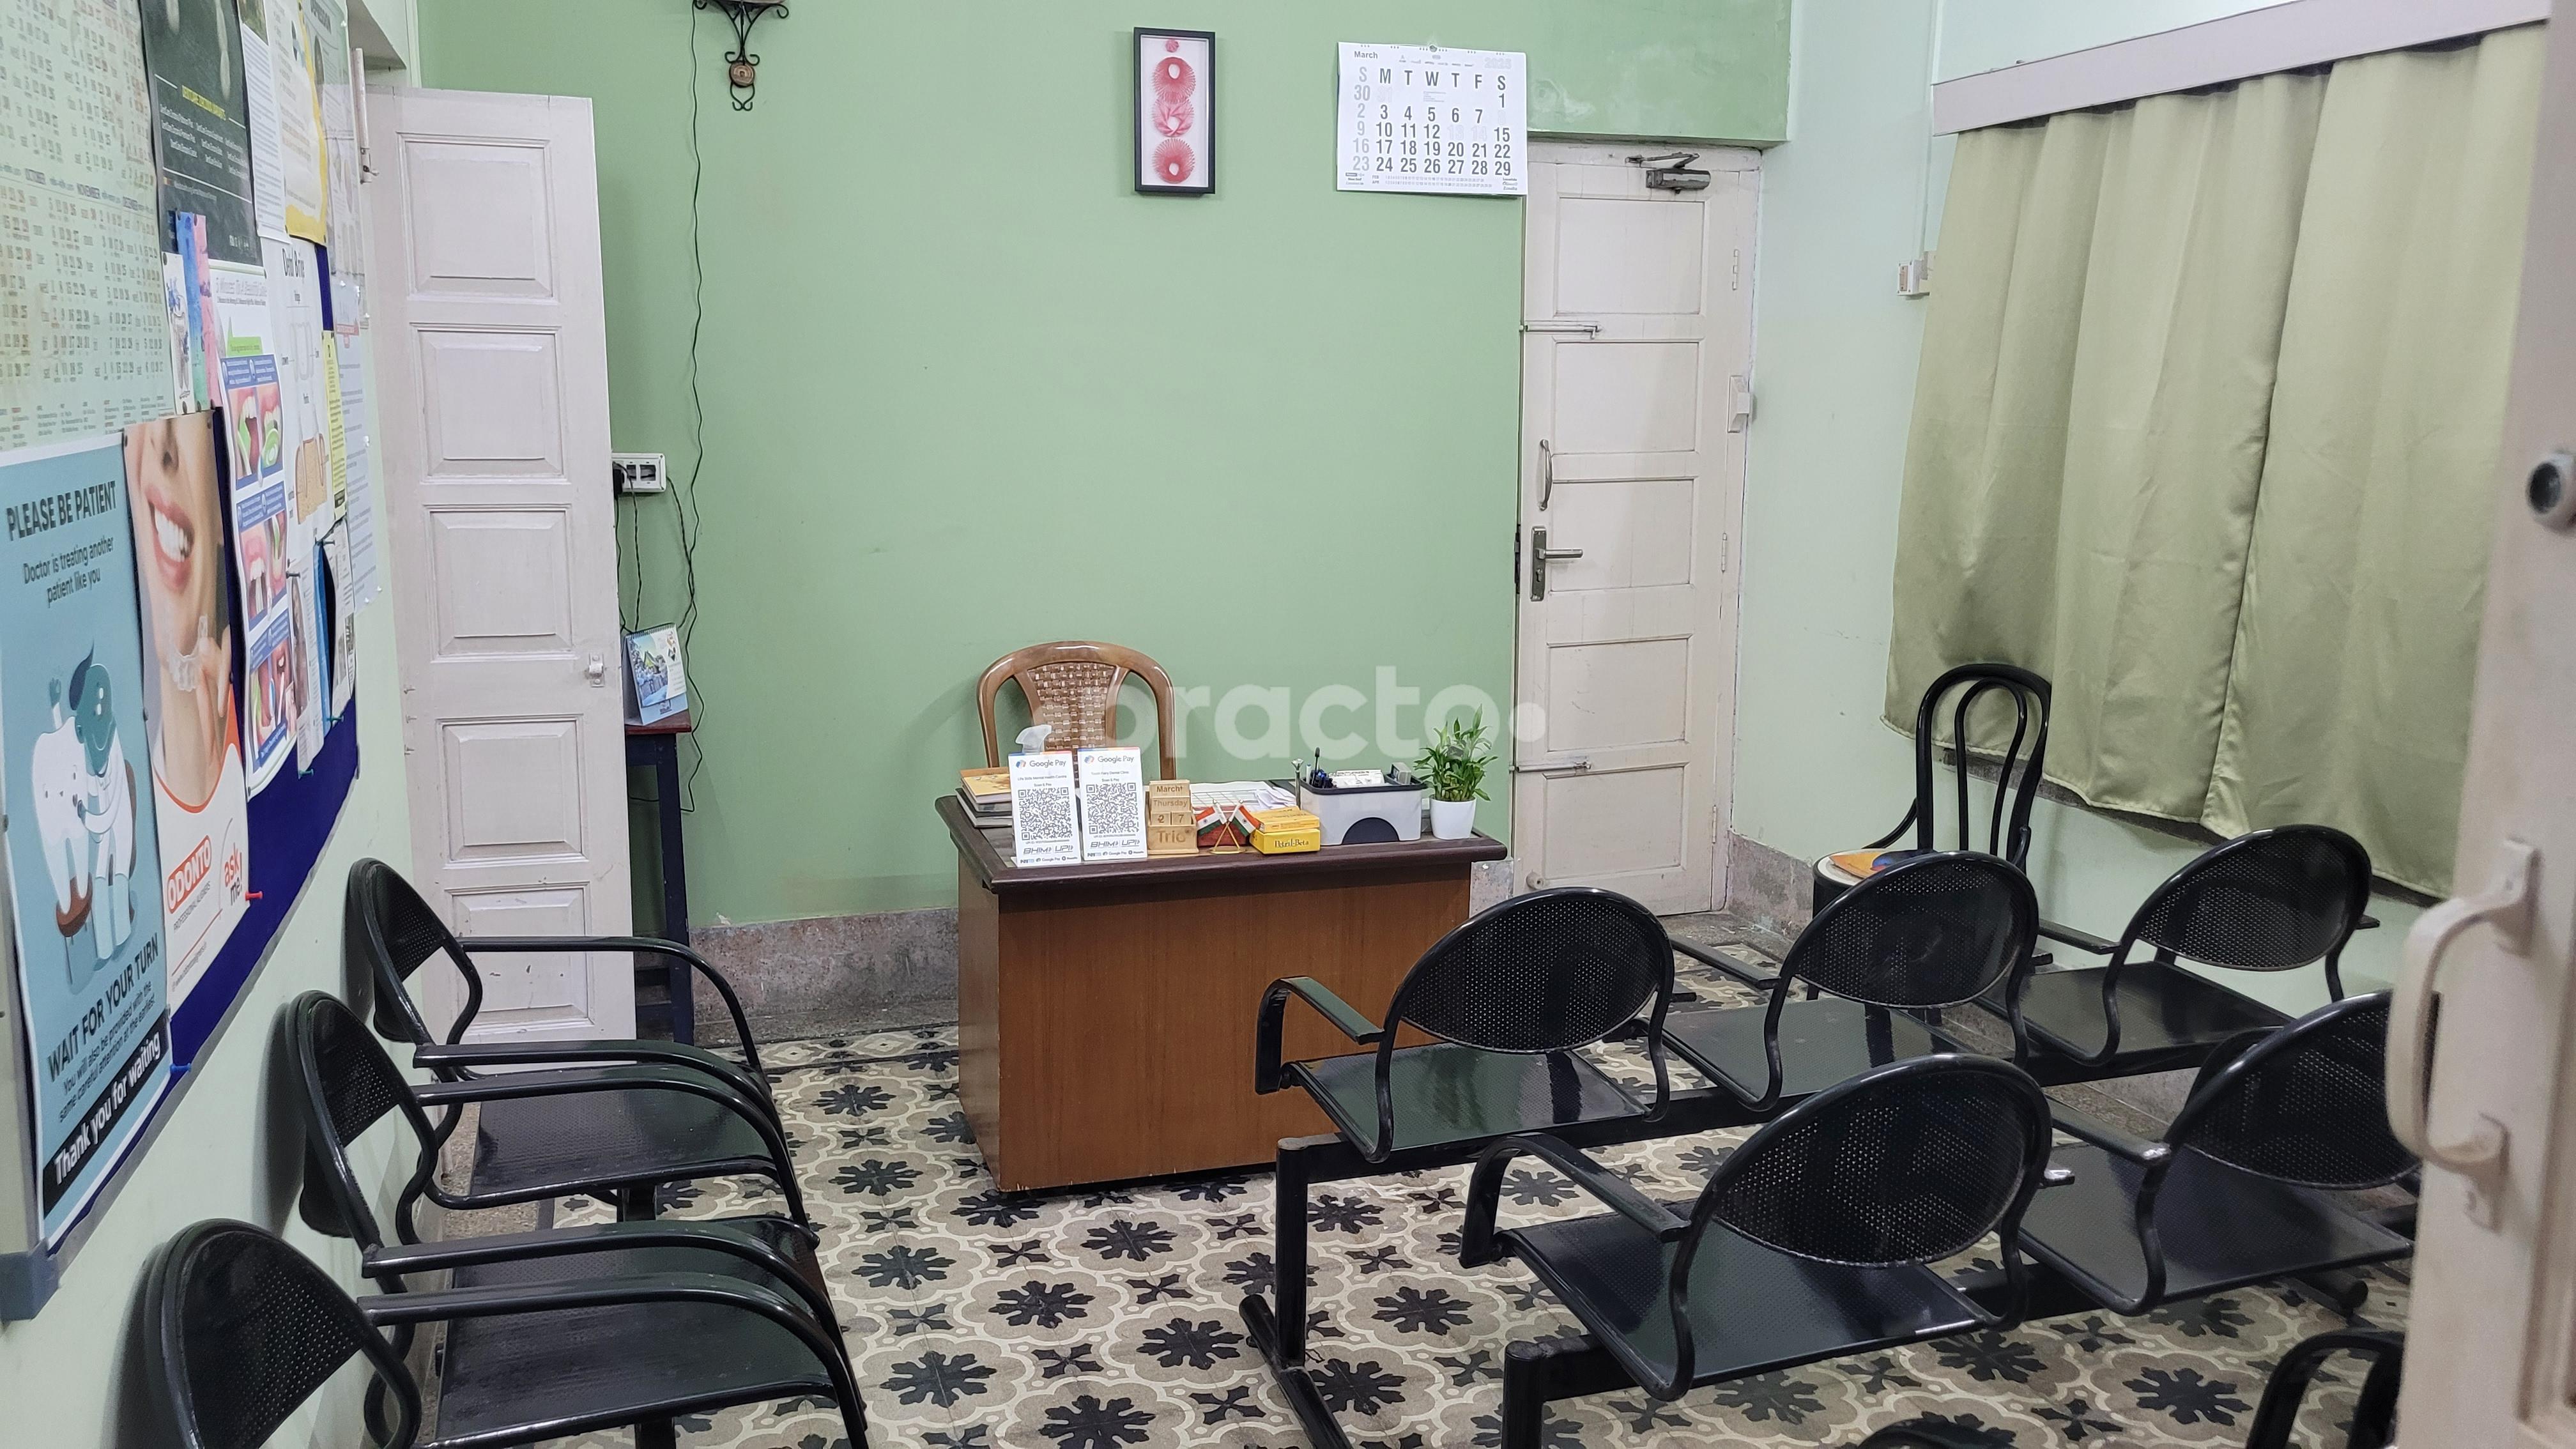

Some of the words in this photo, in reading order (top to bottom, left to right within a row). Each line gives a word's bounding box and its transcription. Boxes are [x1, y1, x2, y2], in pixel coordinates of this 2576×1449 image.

[1354, 50, 1377, 59] March
[1359, 66, 1367, 82] S
[1380, 68, 1391, 84] M
[1404, 70, 1413, 85] T
[1425, 72, 1439, 86] W
[1451, 73, 1459, 87] T
[1475, 74, 1482, 89] F
[1497, 75, 1506, 90] S
[1354, 85, 1370, 101] 30
[1499, 93, 1505, 108] 1
[1357, 103, 1365, 118] 2
[1380, 105, 1388, 119] 3
[1404, 106, 1412, 120] 4
[1428, 107, 1436, 121] 5
[1452, 108, 1459, 123] 6
[1475, 109, 1482, 124] 7
[1357, 121, 1365, 136] 9
[1376, 123, 1393, 137] 10
[1401, 123, 1416, 138] 11
[1424, 125, 1440, 139] 12
[1494, 127, 1510, 142] 15
[1353, 139, 1369, 153] 16
[1376, 140, 1393, 154] 17
[1400, 141, 1416, 155] 18
[1424, 141, 1440, 156] 19
[1448, 142, 1464, 157] 20
[1472, 143, 1486, 158] 21
[1494, 144, 1510, 158] 22
[1353, 156, 1370, 171] 23
[1376, 157, 1393, 171] 24
[1400, 158, 1416, 172] 25
[1424, 159, 1441, 174] 26
[1448, 160, 1464, 174] 27
[1471, 160, 1487, 175] 28
[1495, 162, 1511, 176] 29
[6, 496, 56, 541] PLEASE
[57, 492, 73, 526] BE
[74, 480, 117, 521] PATIENT
[24, 557, 50, 584] Doctor
[52, 553, 59, 573] is
[59, 544, 88, 570] treating
[89, 535, 114, 560] another
[47, 578, 74, 608] patient
[74, 570, 87, 593] like
[88, 567, 100, 590] you
[1029, 760, 1053, 769] Google
[1153, 799, 1187, 808] Thursday
[1158, 815, 1164, 823] 2
[1178, 815, 1184, 823] 7
[1156, 830, 1185, 843] Trio
[168, 838, 211, 910] ODONTO
[224, 842, 240, 887] ask
[230, 852, 243, 906] me!
[47, 1025, 79, 1082] WAIT
[82, 998, 105, 1046] FOR
[105, 963, 134, 1019] YOUR
[134, 931, 158, 983] TURN
[64, 1077, 76, 1096] You
[77, 1057, 88, 1080] will
[89, 1048, 100, 1068] also
[101, 1036, 108, 1052] be
[109, 1002, 132, 1045] provided
[134, 990, 143, 1011] with
[59, 1094, 77, 1123] same
[77, 1064, 98, 1100] careful
[99, 1037, 123, 1073] attention
[124, 1028, 128, 1042] at
[130, 1015, 138, 1034] the
[139, 992, 155, 1023] earliest
[54, 1123, 90, 1186] Thank
[89, 1096, 112, 1146] you
[112, 1080, 127, 1111] for
[128, 1031, 161, 1085] waiting
